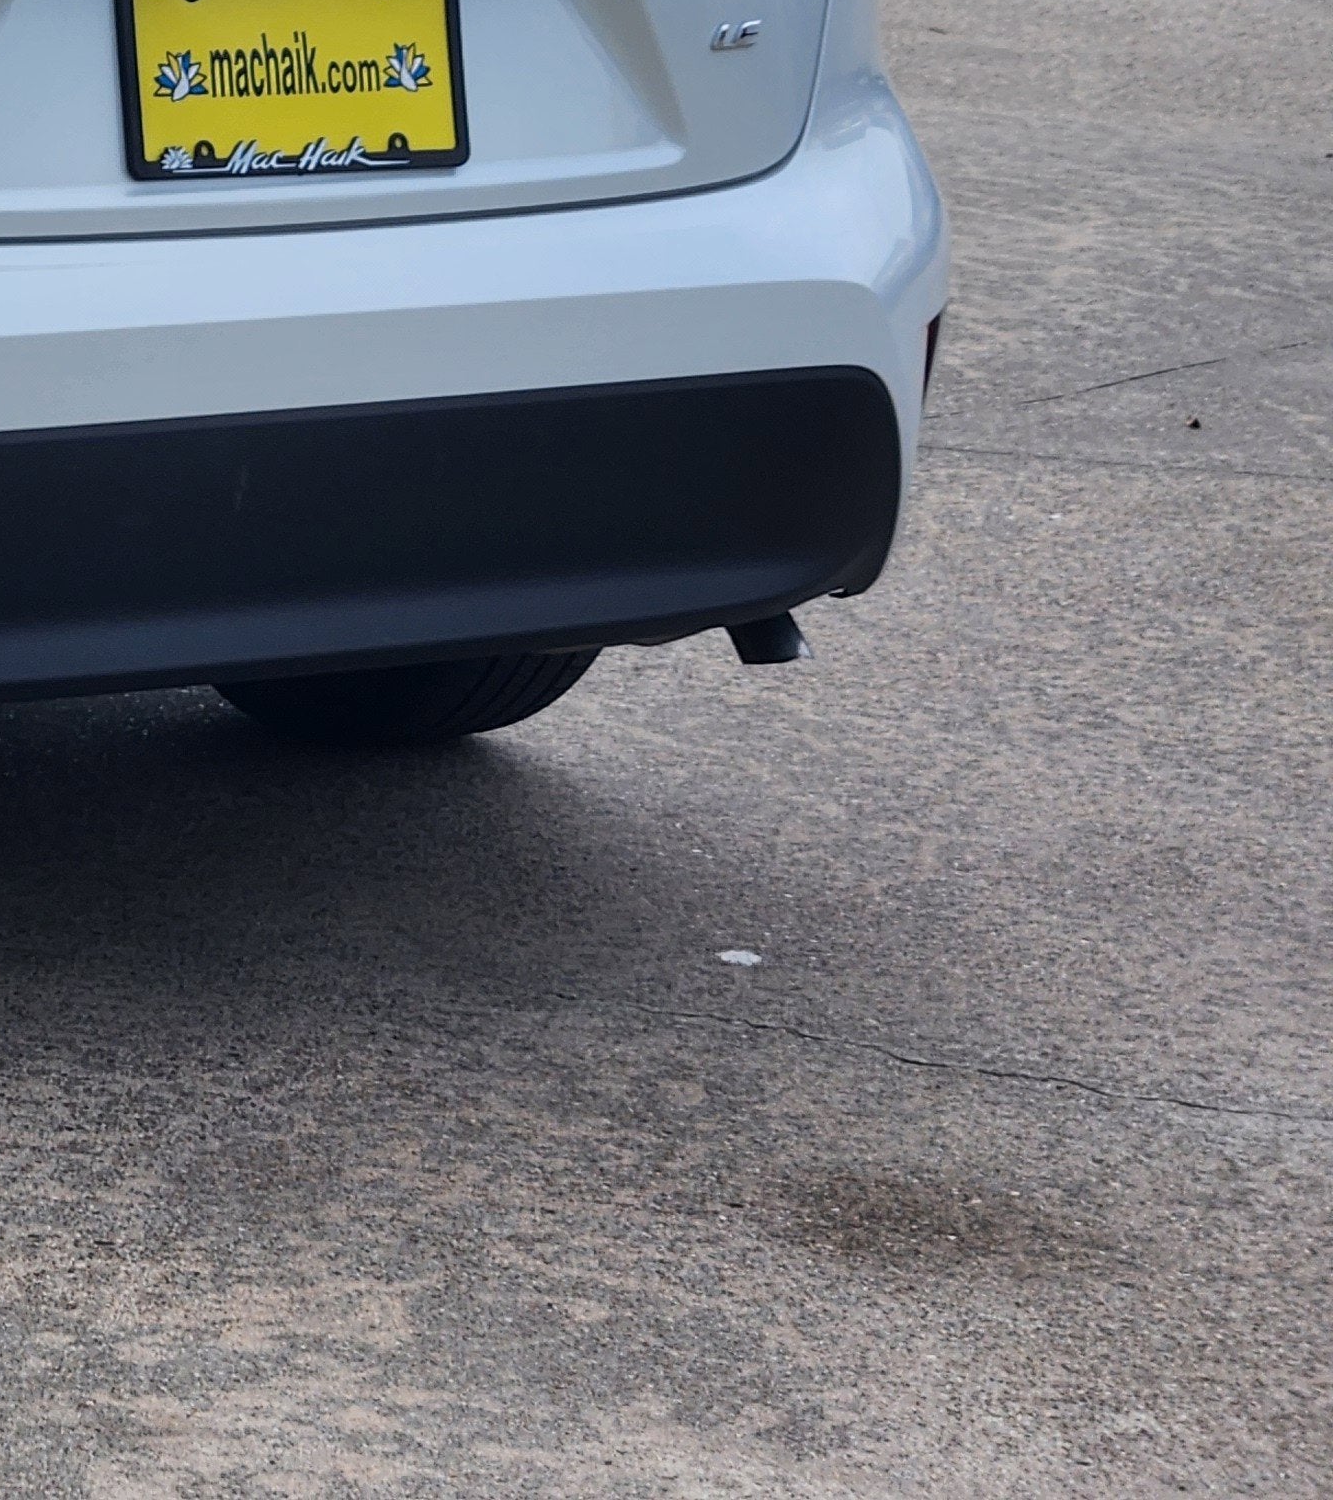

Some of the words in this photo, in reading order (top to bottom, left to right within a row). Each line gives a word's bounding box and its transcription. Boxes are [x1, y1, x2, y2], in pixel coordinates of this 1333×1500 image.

[710, 19, 762, 52] LE
[209, 31, 381, 98] machaik.com
[226, 140, 297, 174] Mac
[298, 137, 410, 171] Haik
